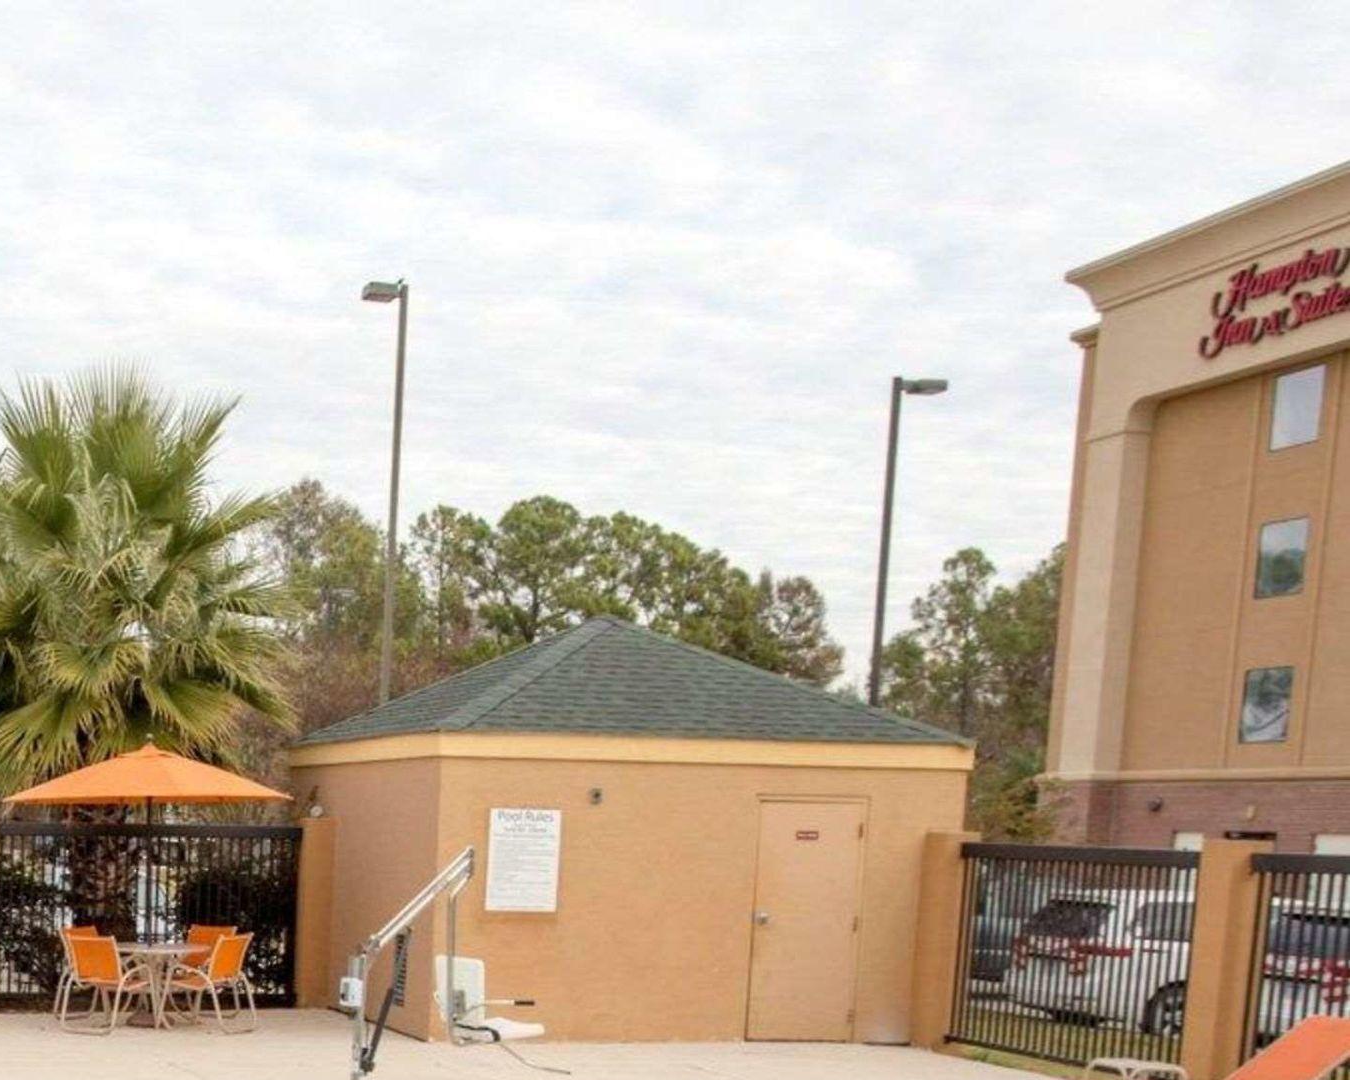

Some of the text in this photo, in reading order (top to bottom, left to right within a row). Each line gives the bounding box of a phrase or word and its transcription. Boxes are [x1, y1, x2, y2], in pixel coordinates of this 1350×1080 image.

[1211, 248, 1350, 318] Hampton
[1199, 315, 1266, 359] Inn
[497, 811, 554, 822] Pool Rules
